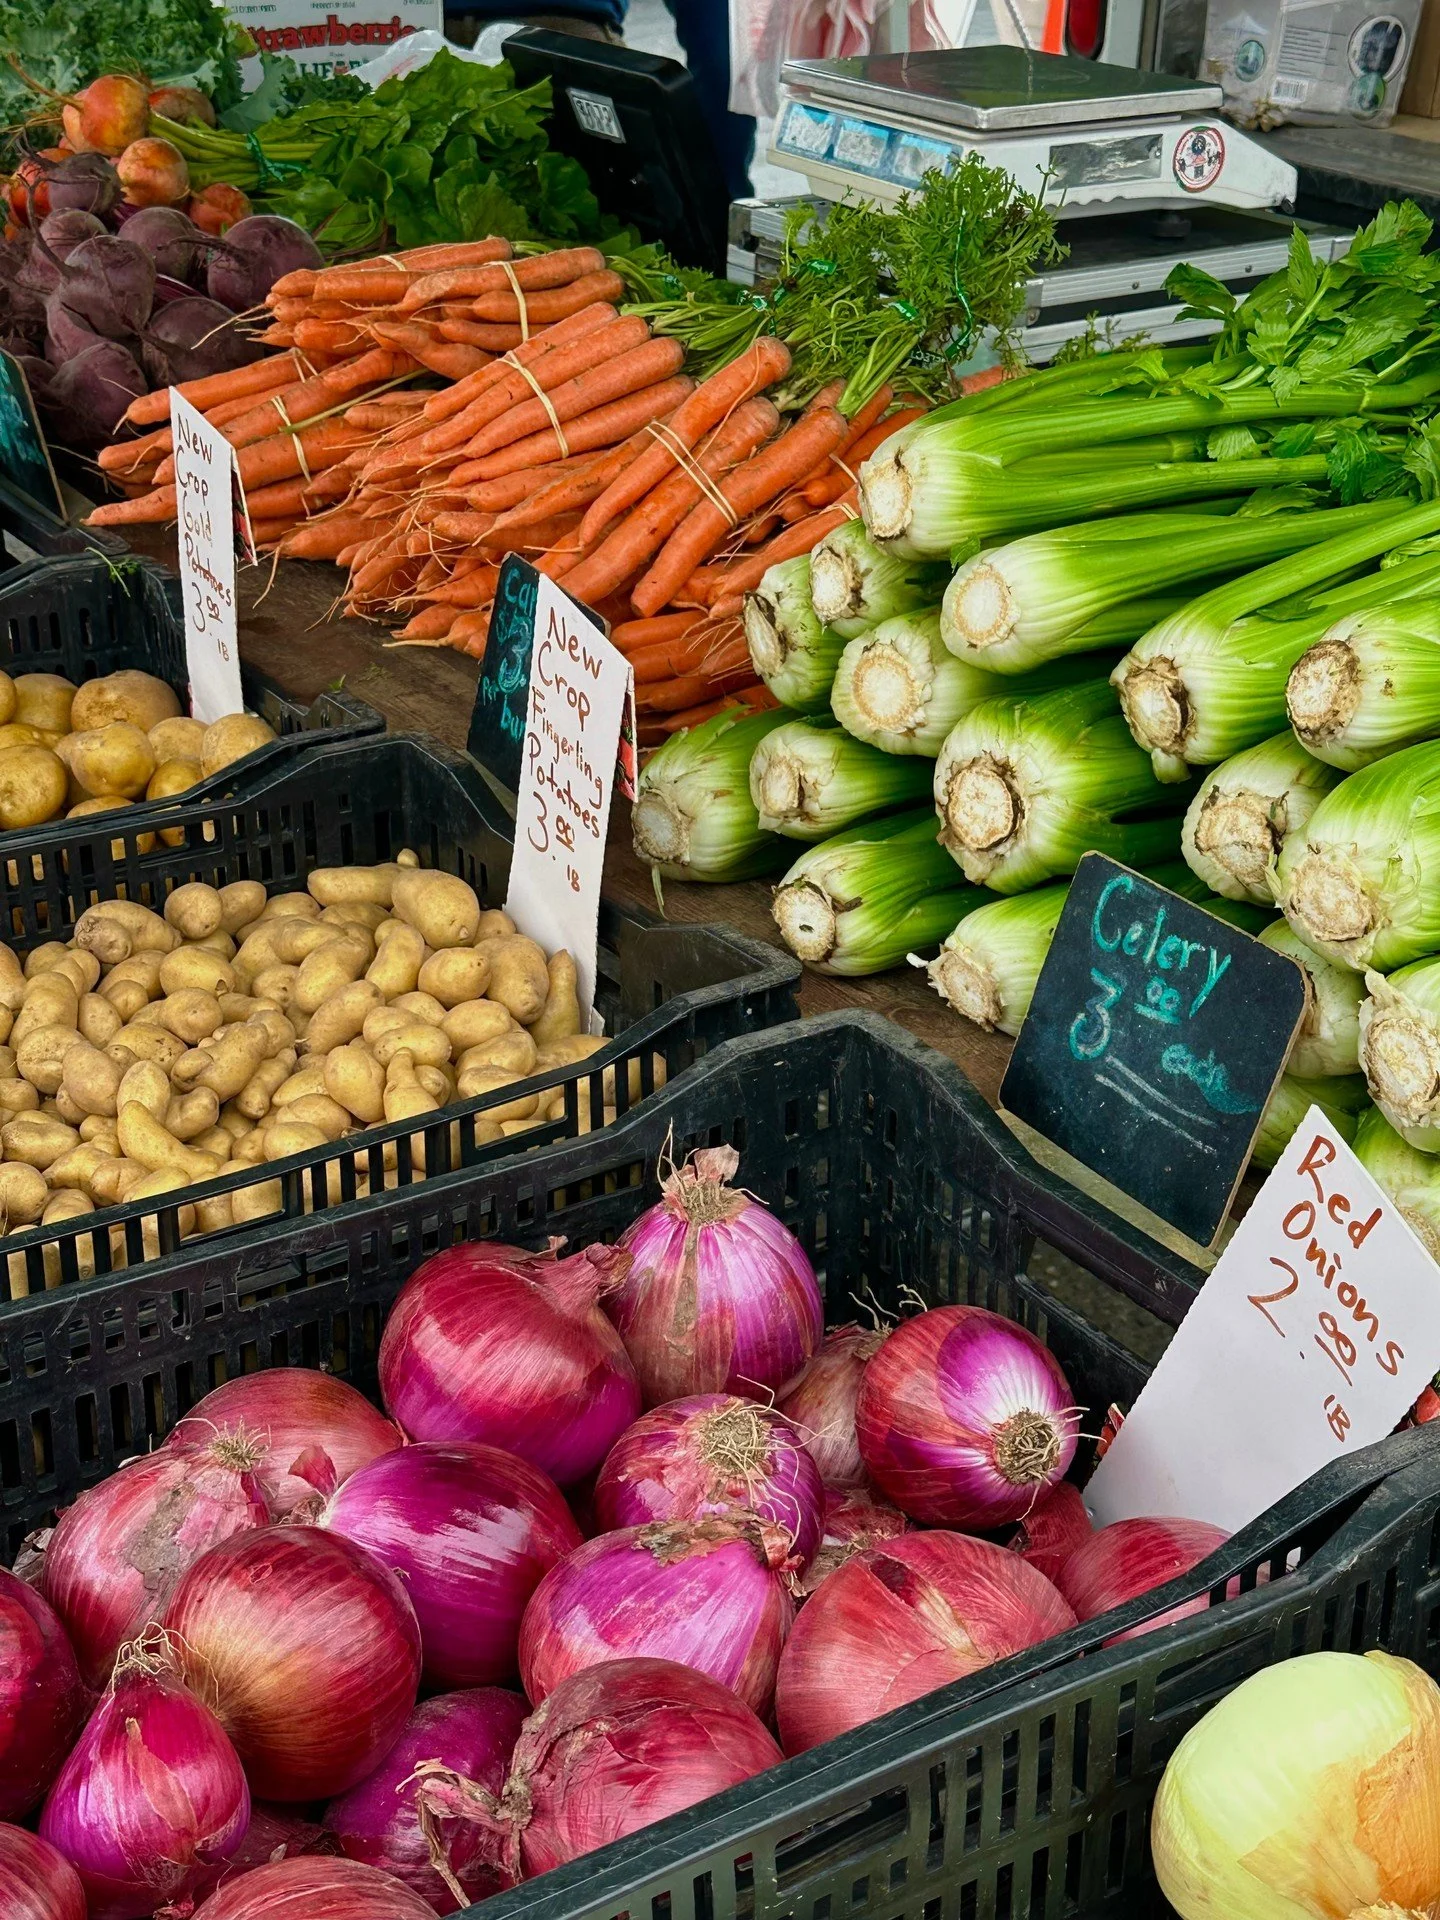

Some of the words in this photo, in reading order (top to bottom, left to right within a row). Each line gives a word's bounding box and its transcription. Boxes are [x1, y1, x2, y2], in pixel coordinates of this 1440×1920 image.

[240, 14, 424, 57] trawberri
[175, 444, 209, 506] Crop
[177, 412, 213, 465] New
[184, 532, 232, 607] Potatoes
[537, 640, 591, 732] Crop
[547, 606, 603, 680] New
[527, 731, 600, 839] Potatoes
[531, 686, 603, 810] Fingerling
[1091, 873, 1232, 1019] Celery
[1296, 1134, 1383, 1249] Red
[1282, 1199, 1405, 1377] Onions
